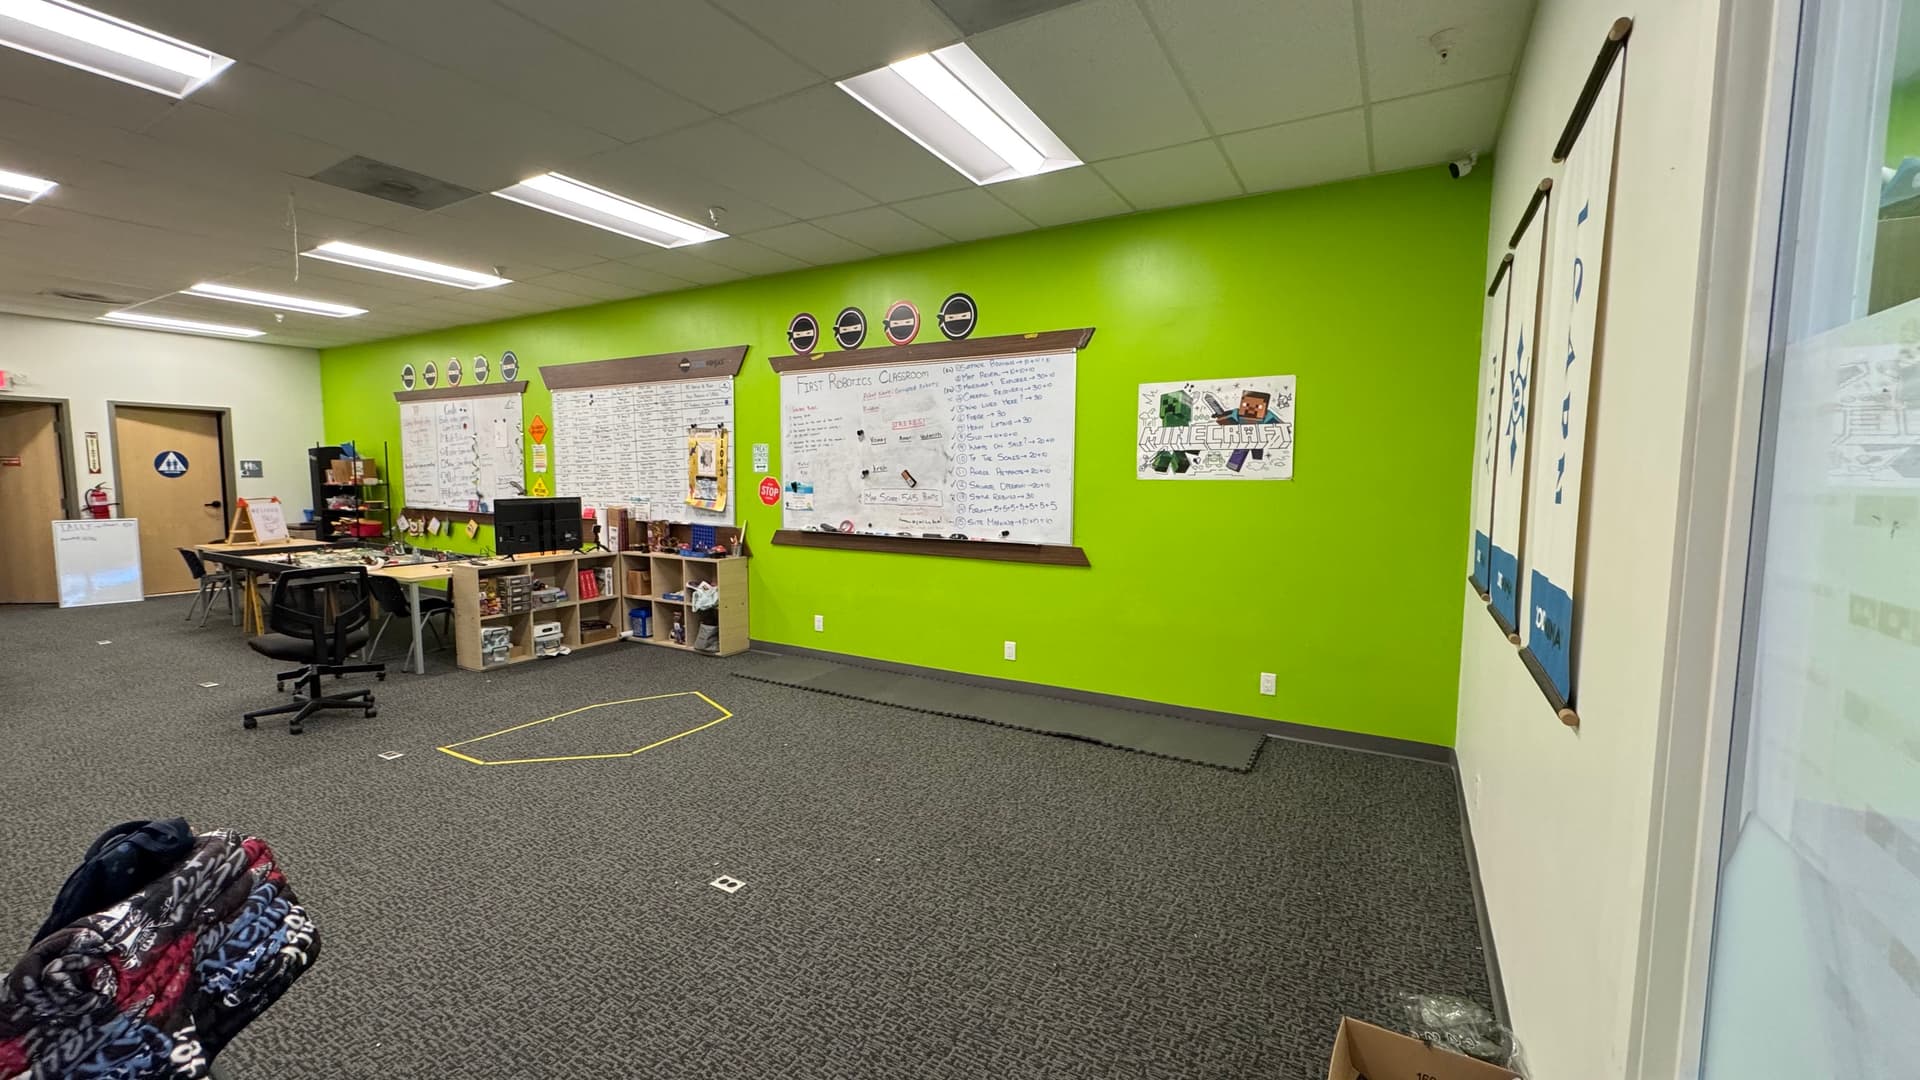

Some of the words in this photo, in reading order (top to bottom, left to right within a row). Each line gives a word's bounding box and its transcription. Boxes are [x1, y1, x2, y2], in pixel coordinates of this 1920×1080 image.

[797, 375, 824, 395] FIRST
[828, 372, 872, 390] ROBOTICS
[879, 370, 929, 384] CLASSROOM
[1138, 423, 1293, 453] MINECRAFT
[760, 485, 779, 497] STOP
